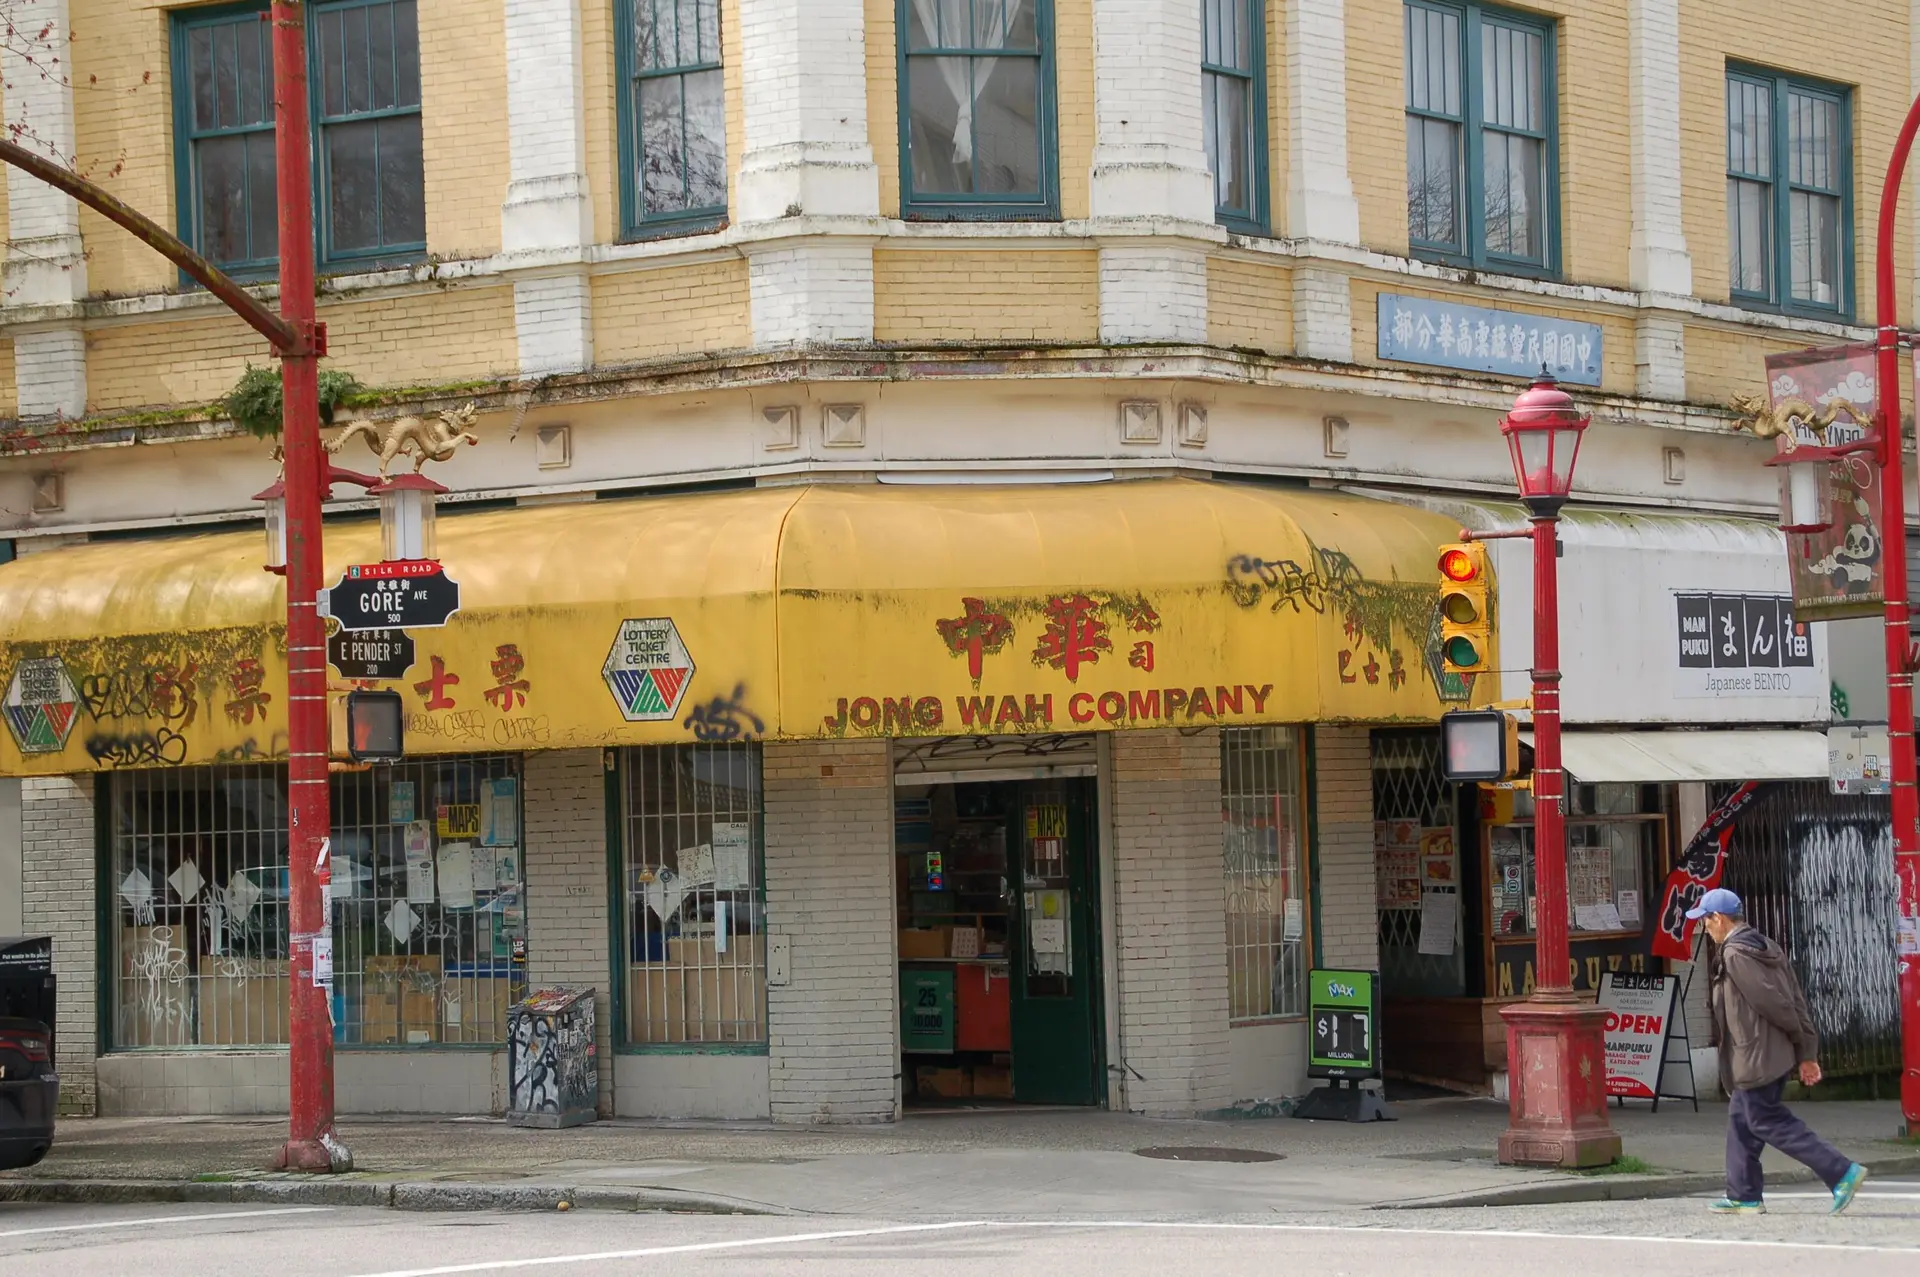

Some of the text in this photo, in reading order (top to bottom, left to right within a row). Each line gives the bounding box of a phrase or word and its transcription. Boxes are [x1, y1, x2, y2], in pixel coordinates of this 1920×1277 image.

[364, 564, 432, 576] SILK ROAD
[360, 590, 428, 613] GORE AVE
[387, 613, 401, 623] 500
[1682, 616, 1706, 633] MAN
[624, 629, 671, 641] LOTTERY
[340, 642, 402, 661] E PENDER ST
[628, 641, 667, 653] TICKET
[1681, 639, 1710, 656] PUKU
[626, 653, 671, 665] CENTRE
[19, 666, 60, 679] LOTTERY
[366, 664, 379, 675] 200
[24, 679, 57, 689] TICKET
[1705, 672, 1791, 696] Japanese BENTO
[21, 689, 61, 700] CENTRE
[824, 684, 1274, 730] JONG WAH COMPANY
[448, 805, 479, 833] MAPS
[1036, 804, 1067, 837] MAPS
[918, 988, 938, 1007] 25
[1328, 983, 1354, 998] MAX
[1604, 1012, 1662, 1035] OPEN
